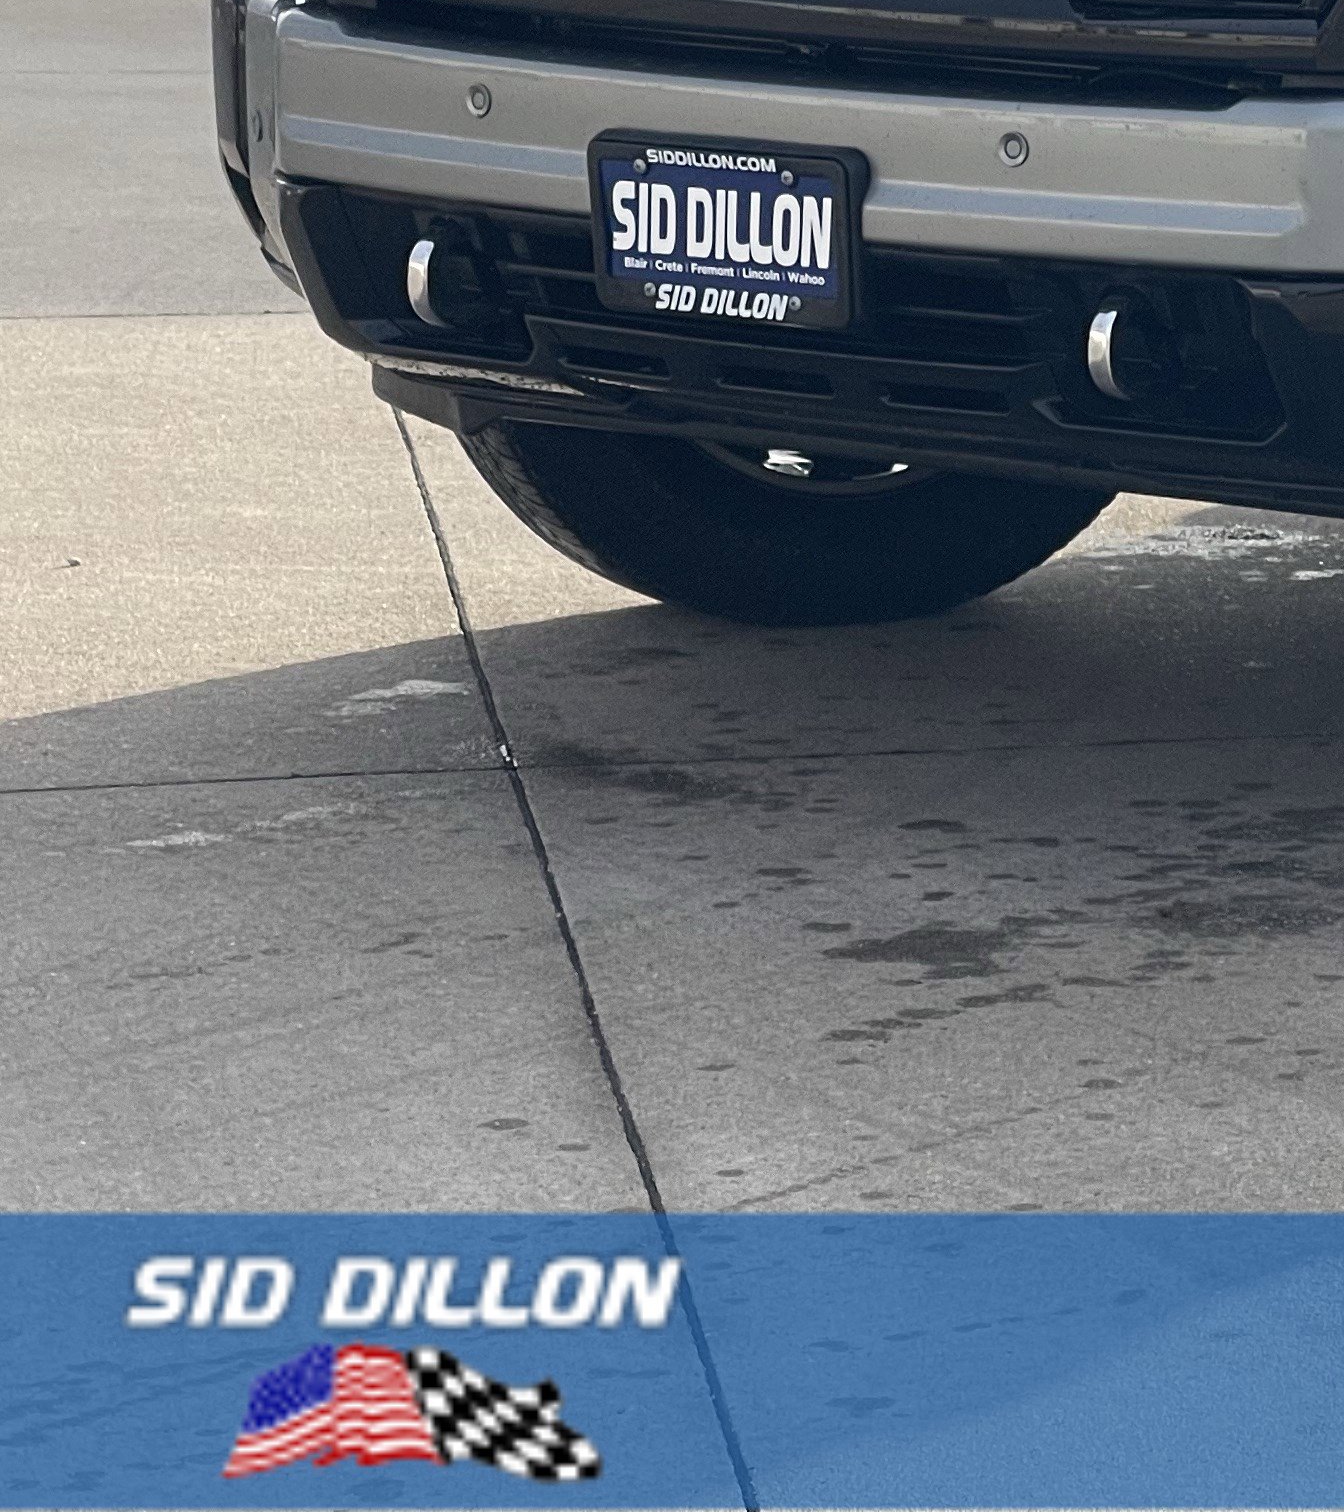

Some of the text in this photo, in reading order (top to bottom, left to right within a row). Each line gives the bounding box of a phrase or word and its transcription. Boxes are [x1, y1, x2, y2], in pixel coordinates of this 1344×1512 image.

[646, 148, 777, 173] SIDDILLON.COM
[612, 180, 832, 270] SID DILLON
[624, 256, 826, 286] Blair Crete Fremont Lincoln Wahoo
[655, 283, 789, 322] SID DILLON
